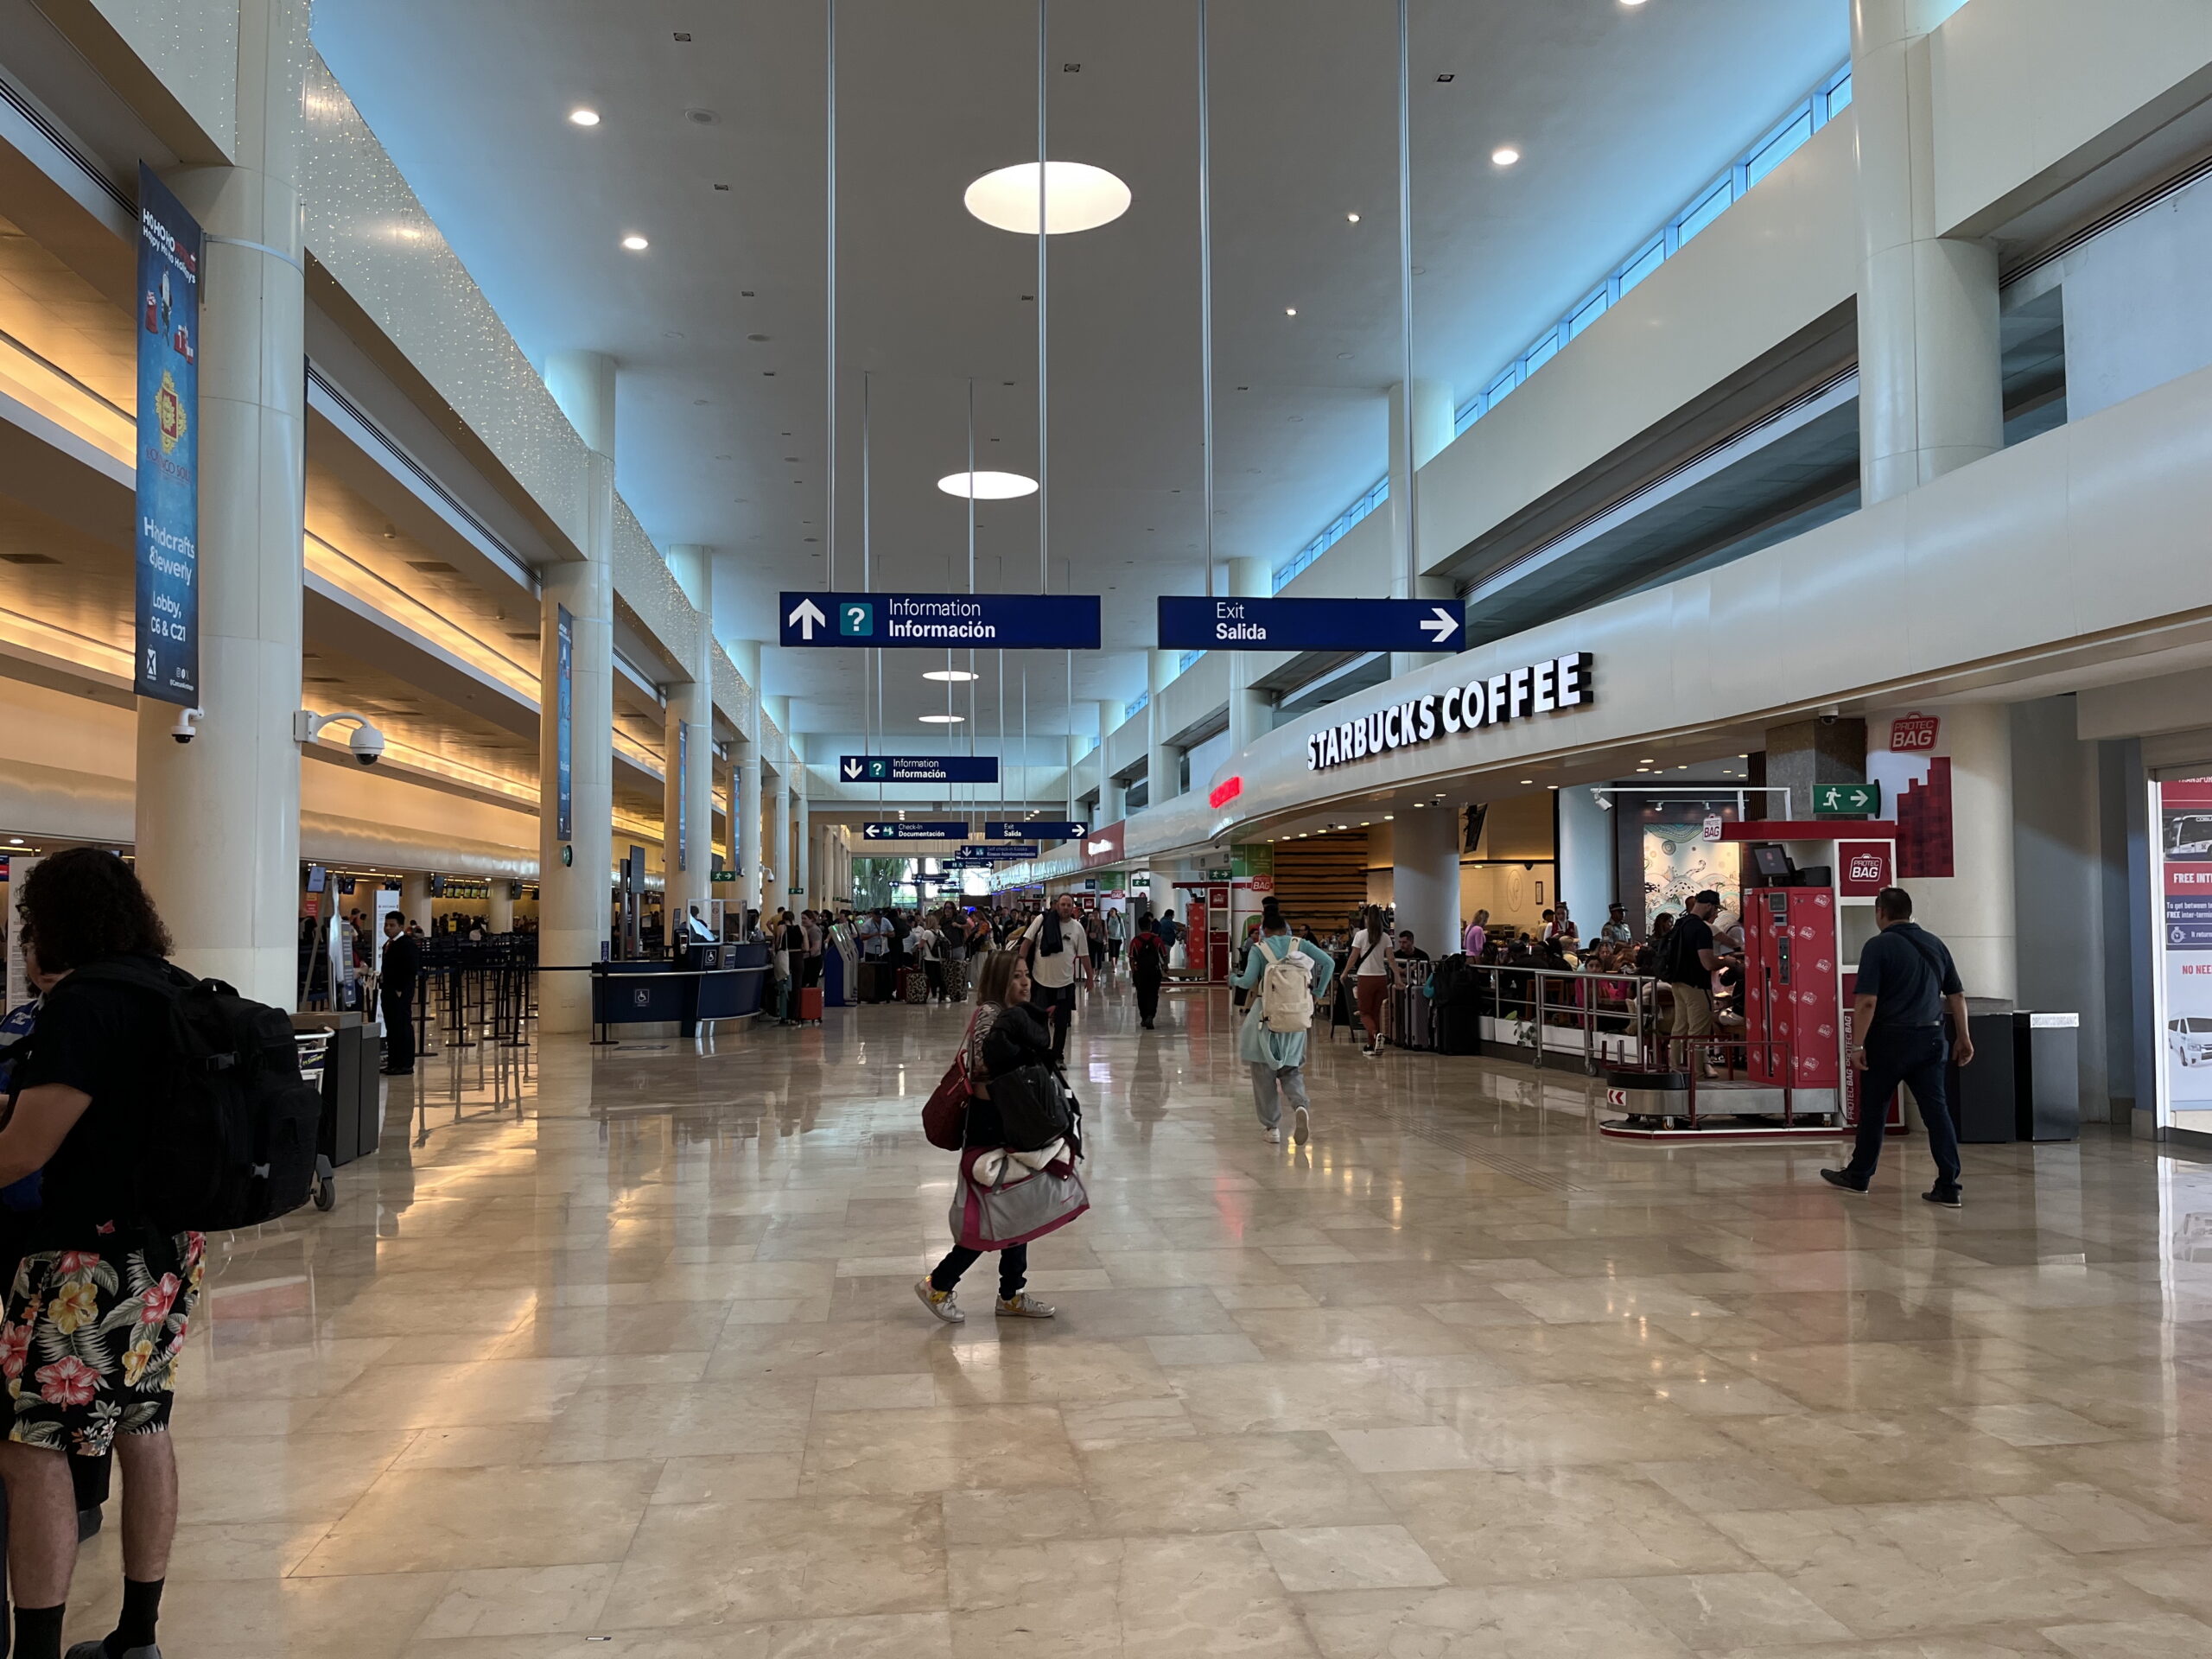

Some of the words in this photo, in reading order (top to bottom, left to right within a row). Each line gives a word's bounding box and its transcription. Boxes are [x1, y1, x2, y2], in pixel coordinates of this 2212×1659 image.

[153, 590, 181, 619] Lobby,
[889, 598, 981, 617] Information
[1217, 601, 1244, 619] Exit
[150, 616, 161, 634] C6
[162, 620, 168, 636] &
[170, 623, 186, 642] C21
[888, 620, 995, 639] Información
[1216, 622, 1267, 640] Salida
[1306, 694, 1436, 771] STARBUCKS
[1441, 652, 1586, 734] COFFEE
[1894, 720, 1935, 731] PROTEC
[1892, 730, 1933, 747] BAG
[893, 758, 939, 768] Information
[893, 769, 947, 779] Información
[1704, 826, 1719, 837] BAG
[1852, 867, 1878, 878] BAG
[2173, 873, 2195, 883] FREE
[1252, 881, 1270, 890] BAG
[2182, 964, 2194, 975] NO
